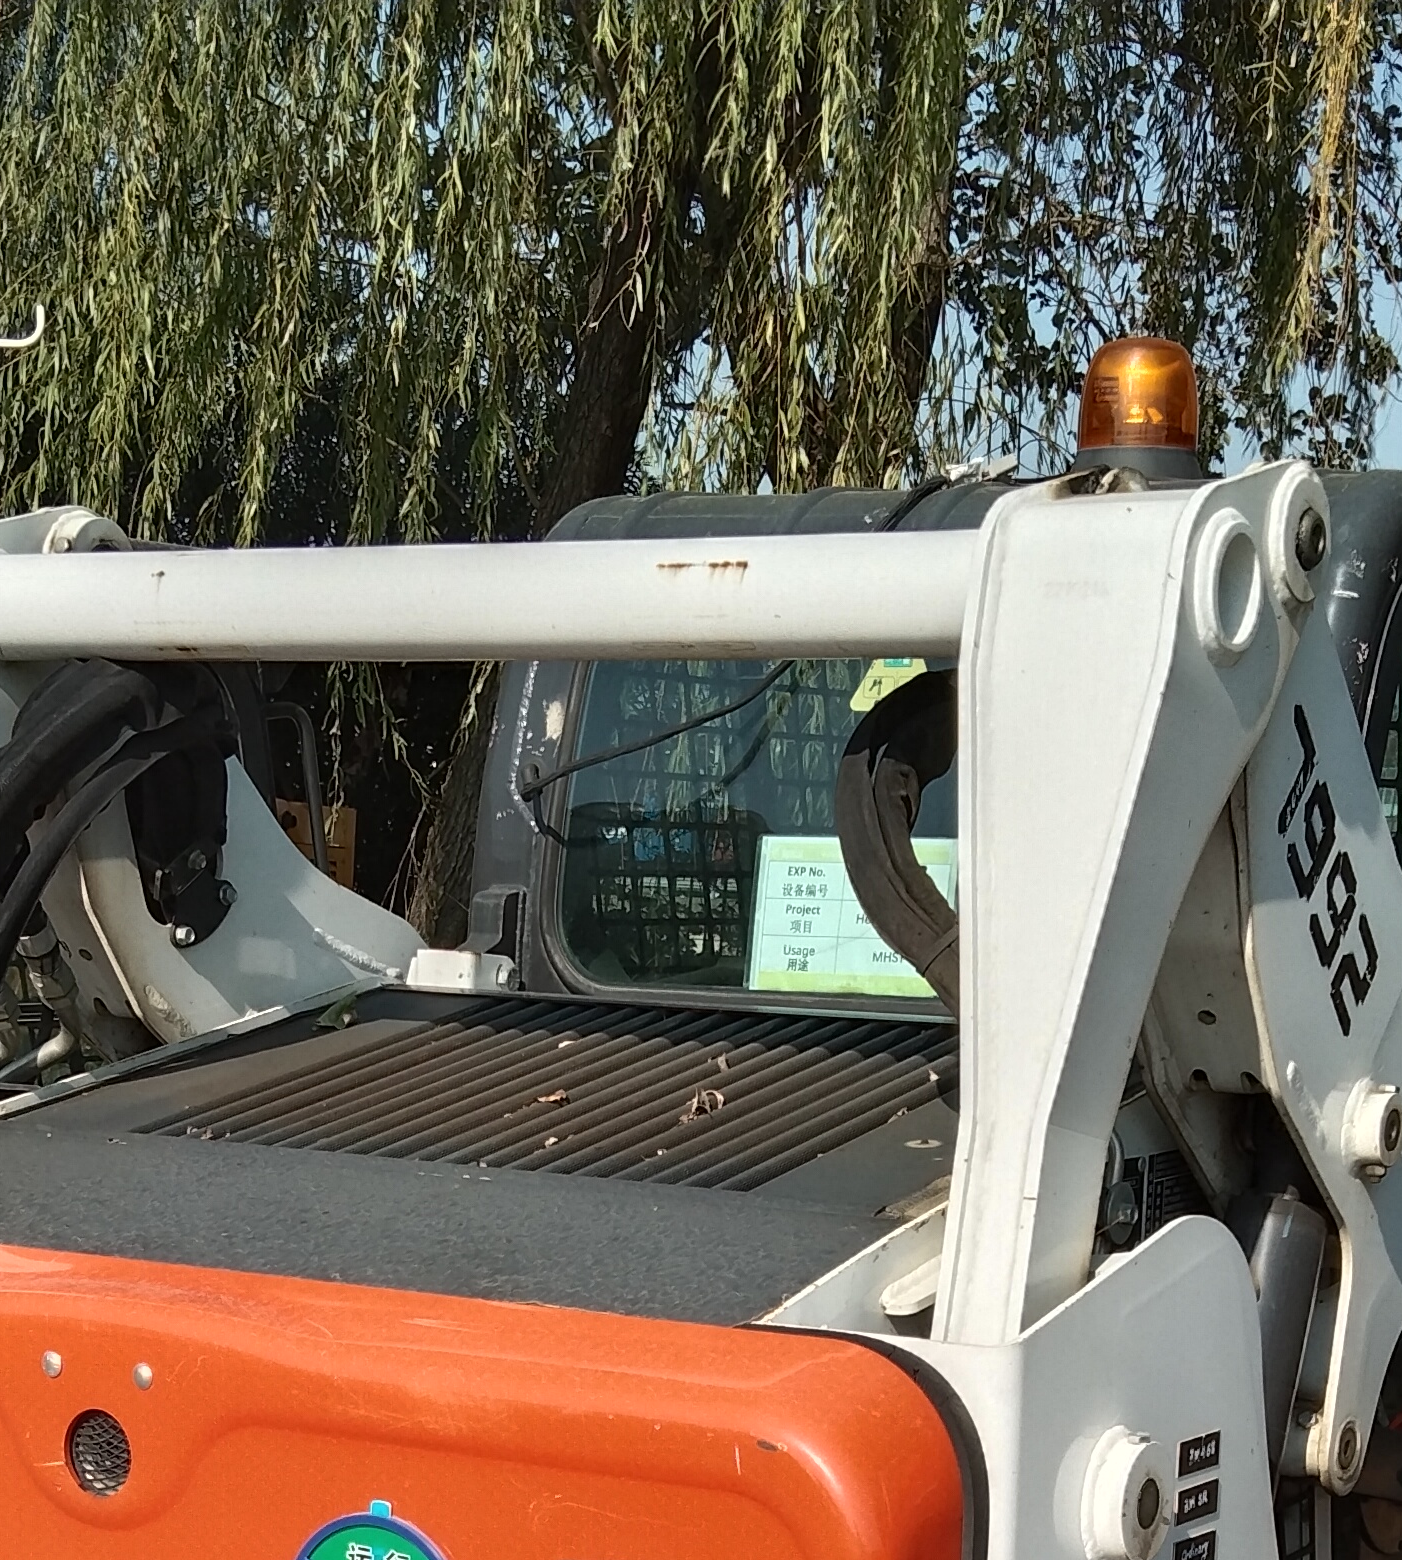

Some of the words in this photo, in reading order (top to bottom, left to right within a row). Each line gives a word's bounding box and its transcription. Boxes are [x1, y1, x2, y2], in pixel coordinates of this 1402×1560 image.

[787, 866, 807, 877] EXP
[809, 867, 826, 877] No.
[1278, 704, 1378, 1037] 7992
[782, 883, 829, 898] 设备编号
[786, 904, 821, 917] Project
[790, 919, 812, 934] 项目
[783, 945, 816, 958] Usage
[786, 958, 809, 972] 用途
